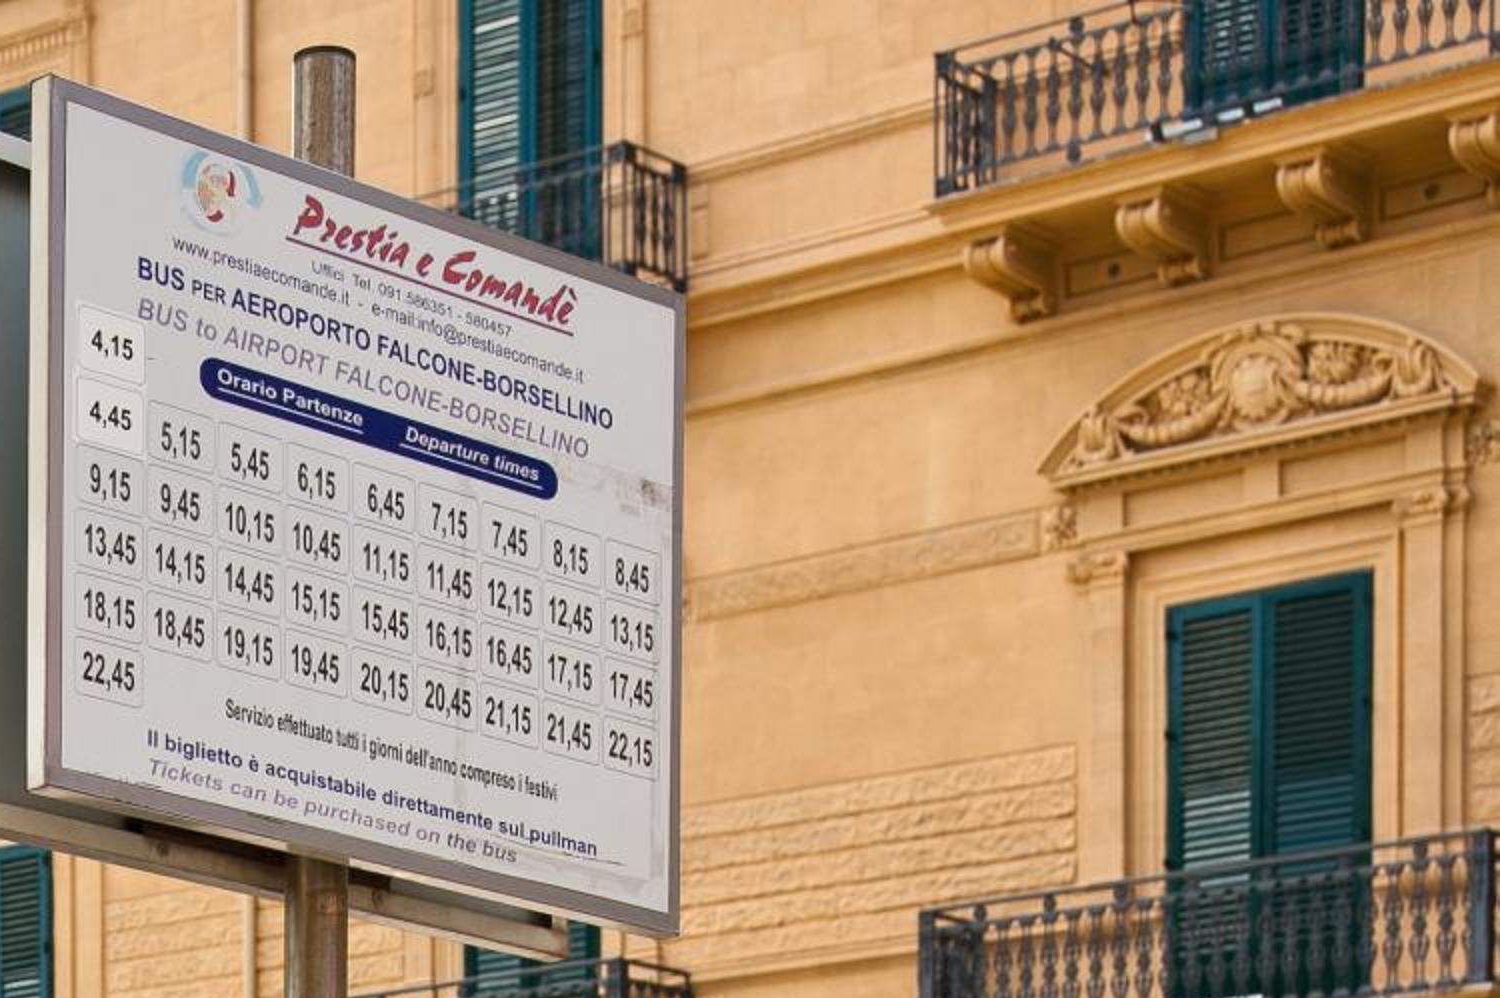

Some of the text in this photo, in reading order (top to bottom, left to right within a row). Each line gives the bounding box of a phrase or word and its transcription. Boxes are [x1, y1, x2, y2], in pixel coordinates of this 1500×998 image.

[173, 237, 349, 305] www.prestiaecomande.it
[293, 194, 578, 325] Prestia e Comandè
[91, 330, 133, 361] 4,15
[138, 256, 613, 430] BUS PER AEROPORTO FALCONE-BORSELLINO
[138, 298, 589, 458] BUS to AIRPORT FALCONE-BORSELLINO
[217, 367, 364, 426] Orario Partenze
[90, 401, 649, 593] 4,45 5,15 5,45 6,15 6,45 7,15 7,45 8,15 8,45
[405, 426, 539, 482] Departure times
[84, 523, 653, 709] 13,45 14,15 14,45 15,15 15,45 16,15 16,45 17,15 17,45
[90, 463, 654, 652] 9,15 9,45 10,15 10,45 11,15 11,45 12,15 12,45 13,15
[83, 650, 135, 691] 22,45
[84, 588, 653, 768] 18,15 18,45 19,15 19,45 20,15 20,45 21,15 21,45 22,15
[148, 729, 598, 857] Il biglietto è acquistabile direttamente sul pullman
[150, 758, 517, 864] Tickets can be purchased on the bus
[225, 698, 275, 729] Servizio
[277, 713, 333, 746] effettuato
[336, 729, 359, 751] tutti
[369, 735, 403, 763] giorni
[405, 747, 458, 777] dell'anno
[459, 762, 515, 790] compreso
[525, 776, 558, 801] festivi
